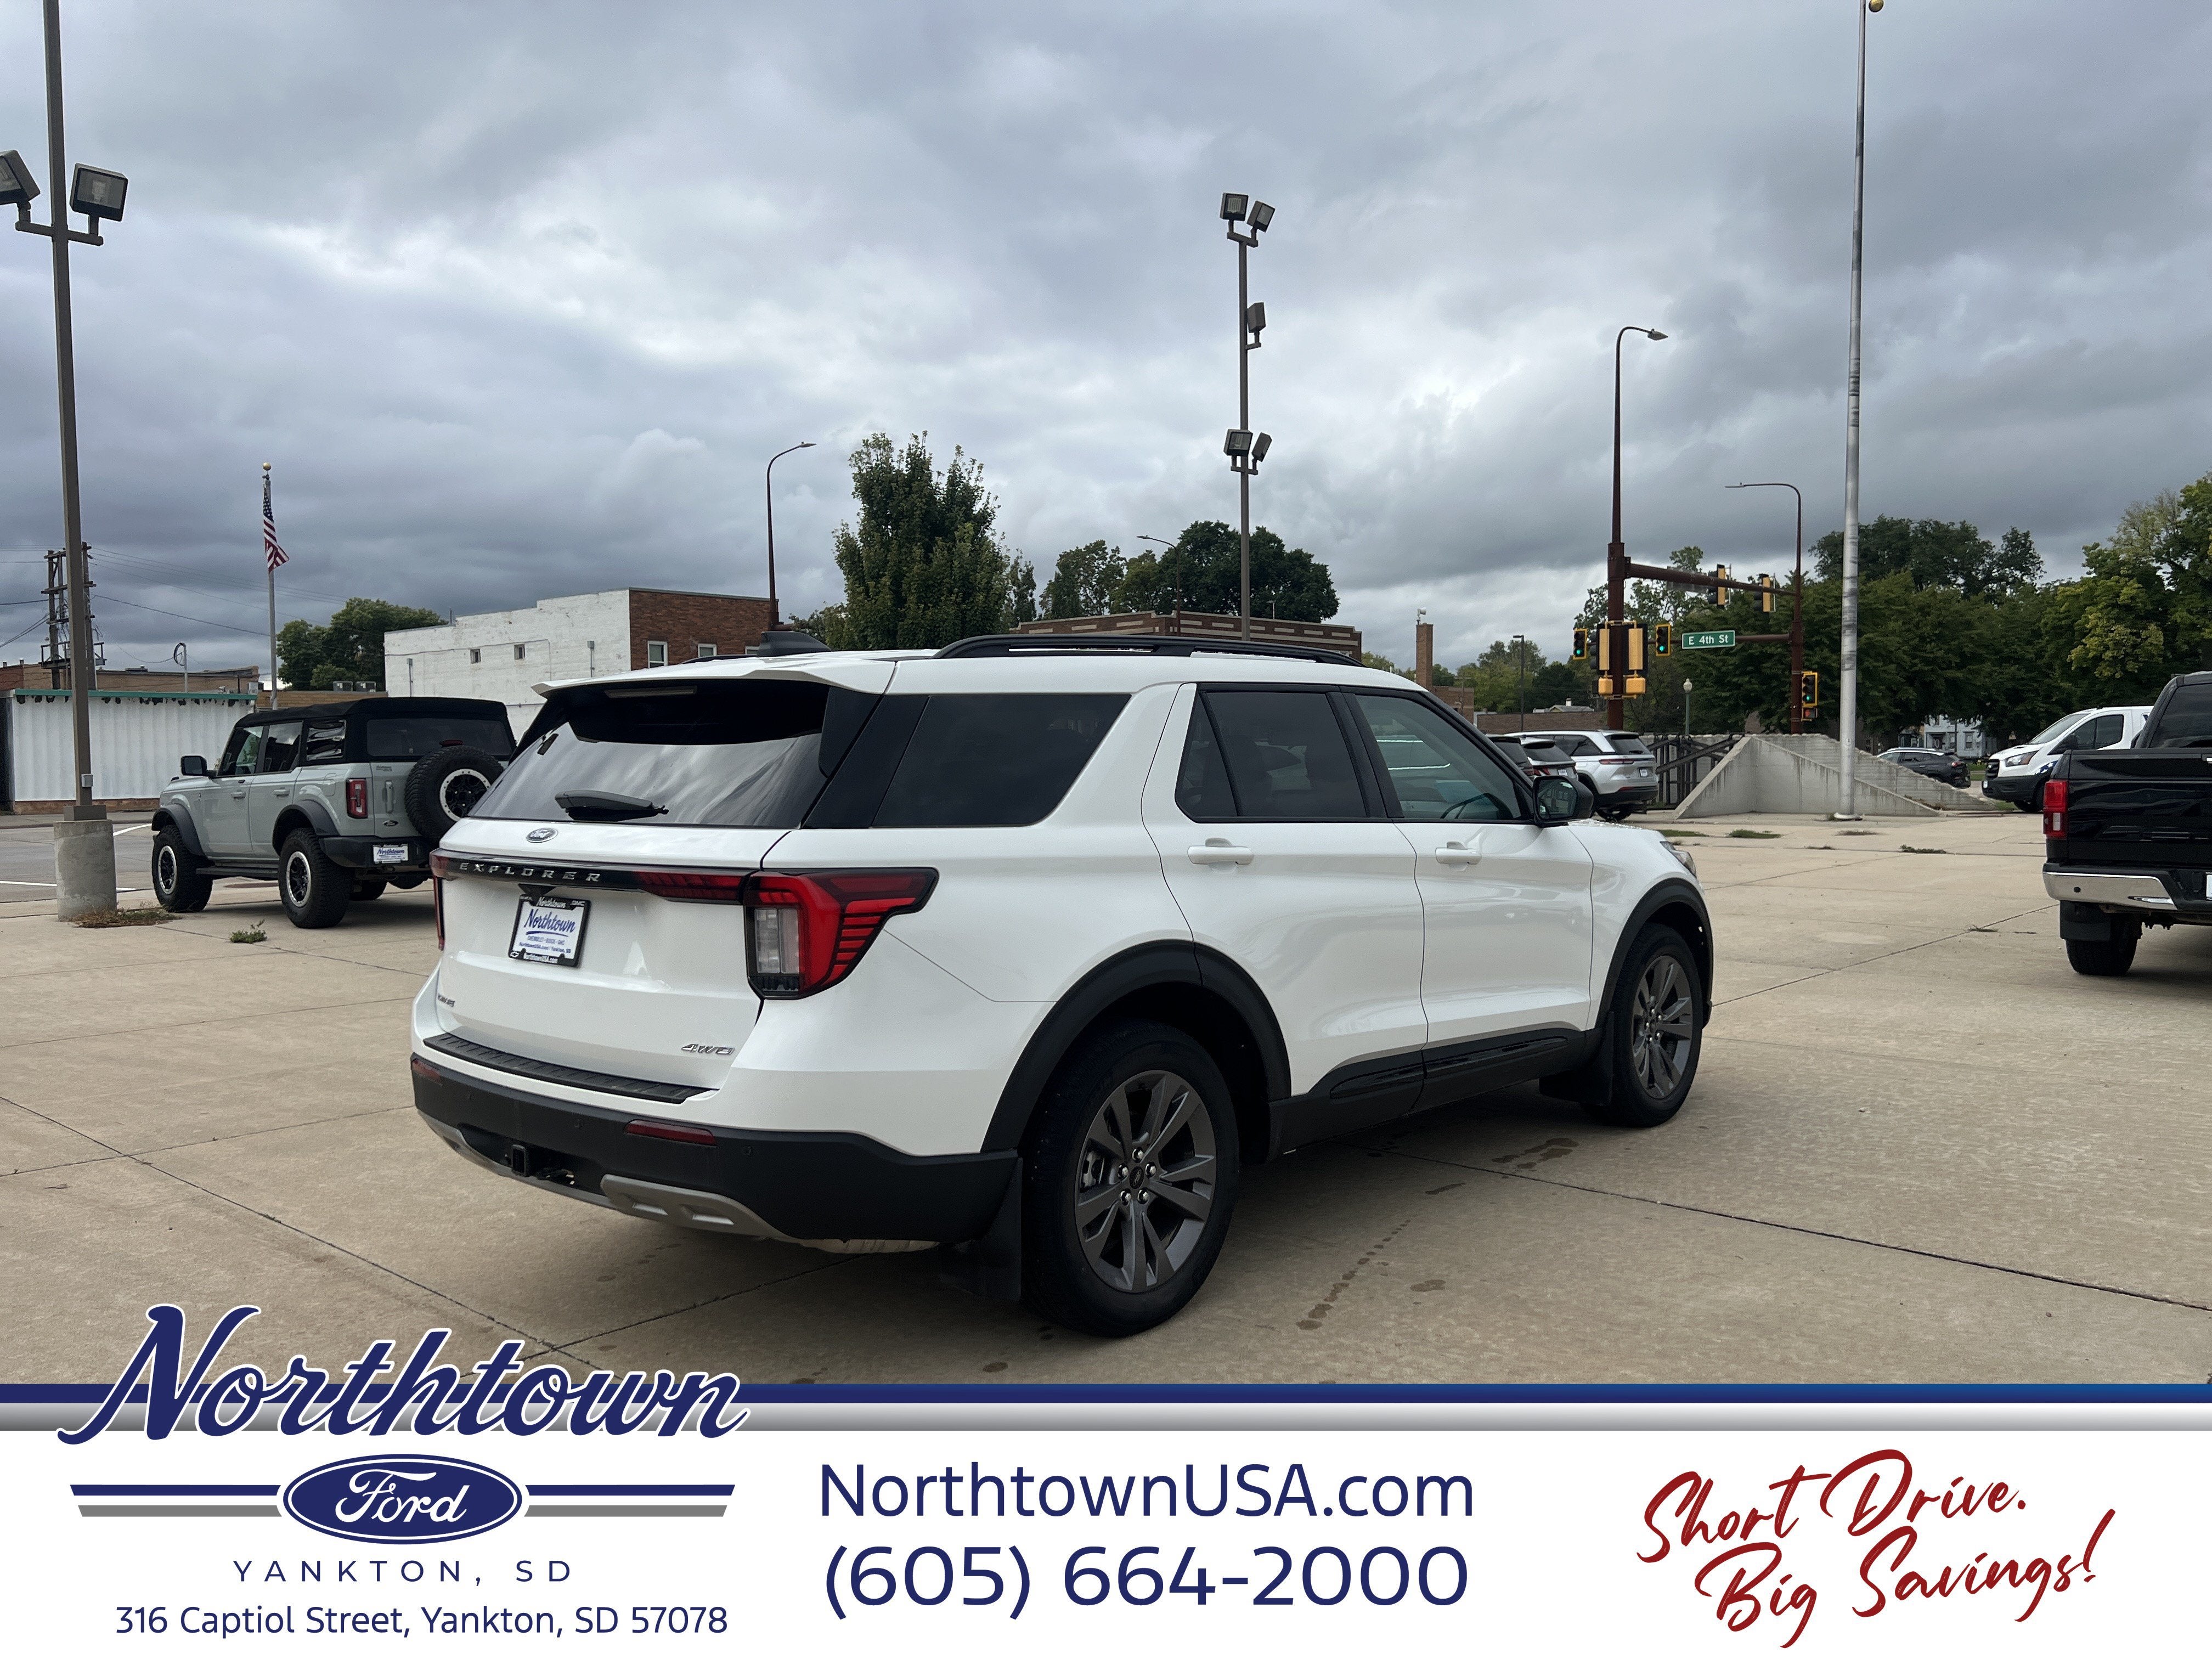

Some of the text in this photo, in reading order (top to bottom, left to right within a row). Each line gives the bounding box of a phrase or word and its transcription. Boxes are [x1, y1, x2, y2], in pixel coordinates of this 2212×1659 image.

[1689, 634, 1729, 645] E 4th St
[459, 862, 601, 882] EXPLORER
[535, 896, 566, 909] Northtown
[523, 909, 576, 933] Northtown
[681, 1043, 735, 1055] 4WD
